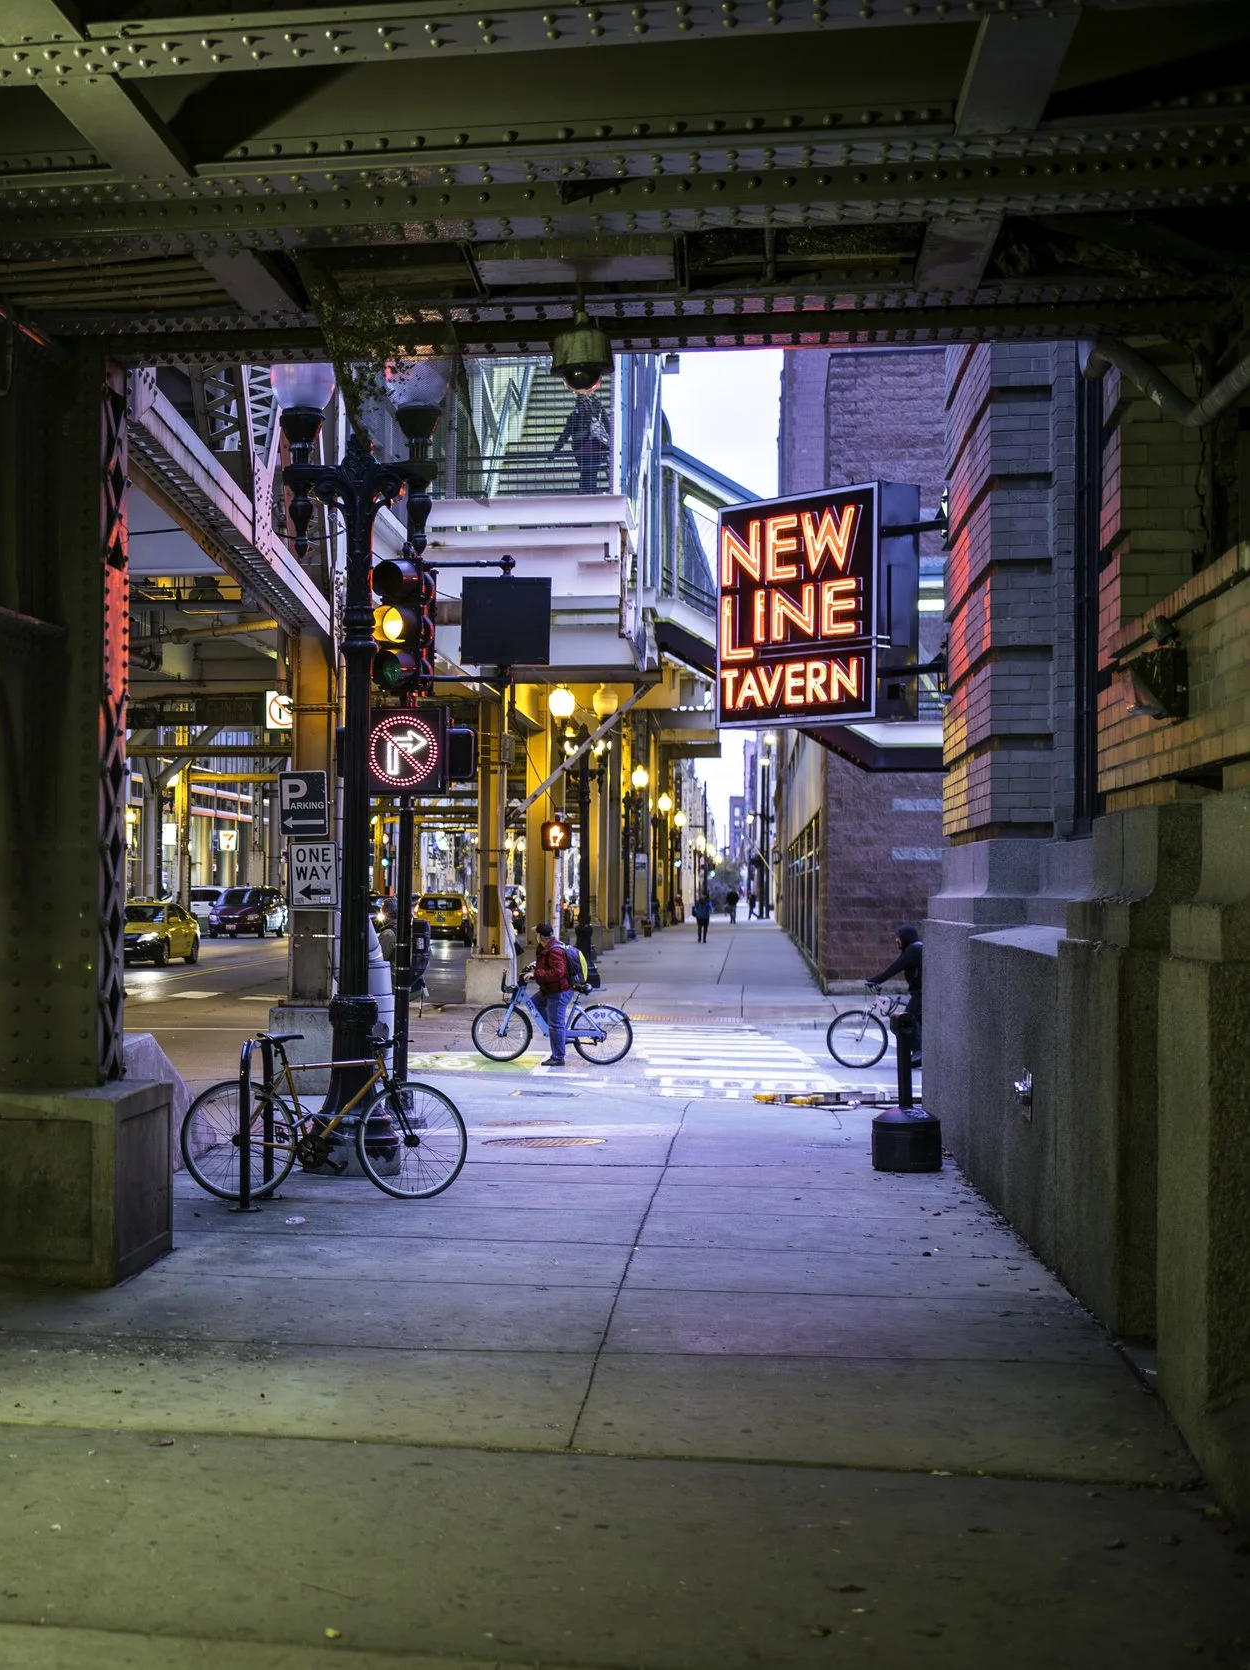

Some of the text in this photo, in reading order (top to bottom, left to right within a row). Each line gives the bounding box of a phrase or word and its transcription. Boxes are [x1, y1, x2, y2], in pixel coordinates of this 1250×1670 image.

[722, 504, 859, 587] NEW
[722, 577, 859, 661] LINE
[721, 657, 860, 710] TAVERN
[281, 778, 325, 810] PARKING
[295, 865, 332, 880] WAY
[296, 848, 332, 863] ONE
